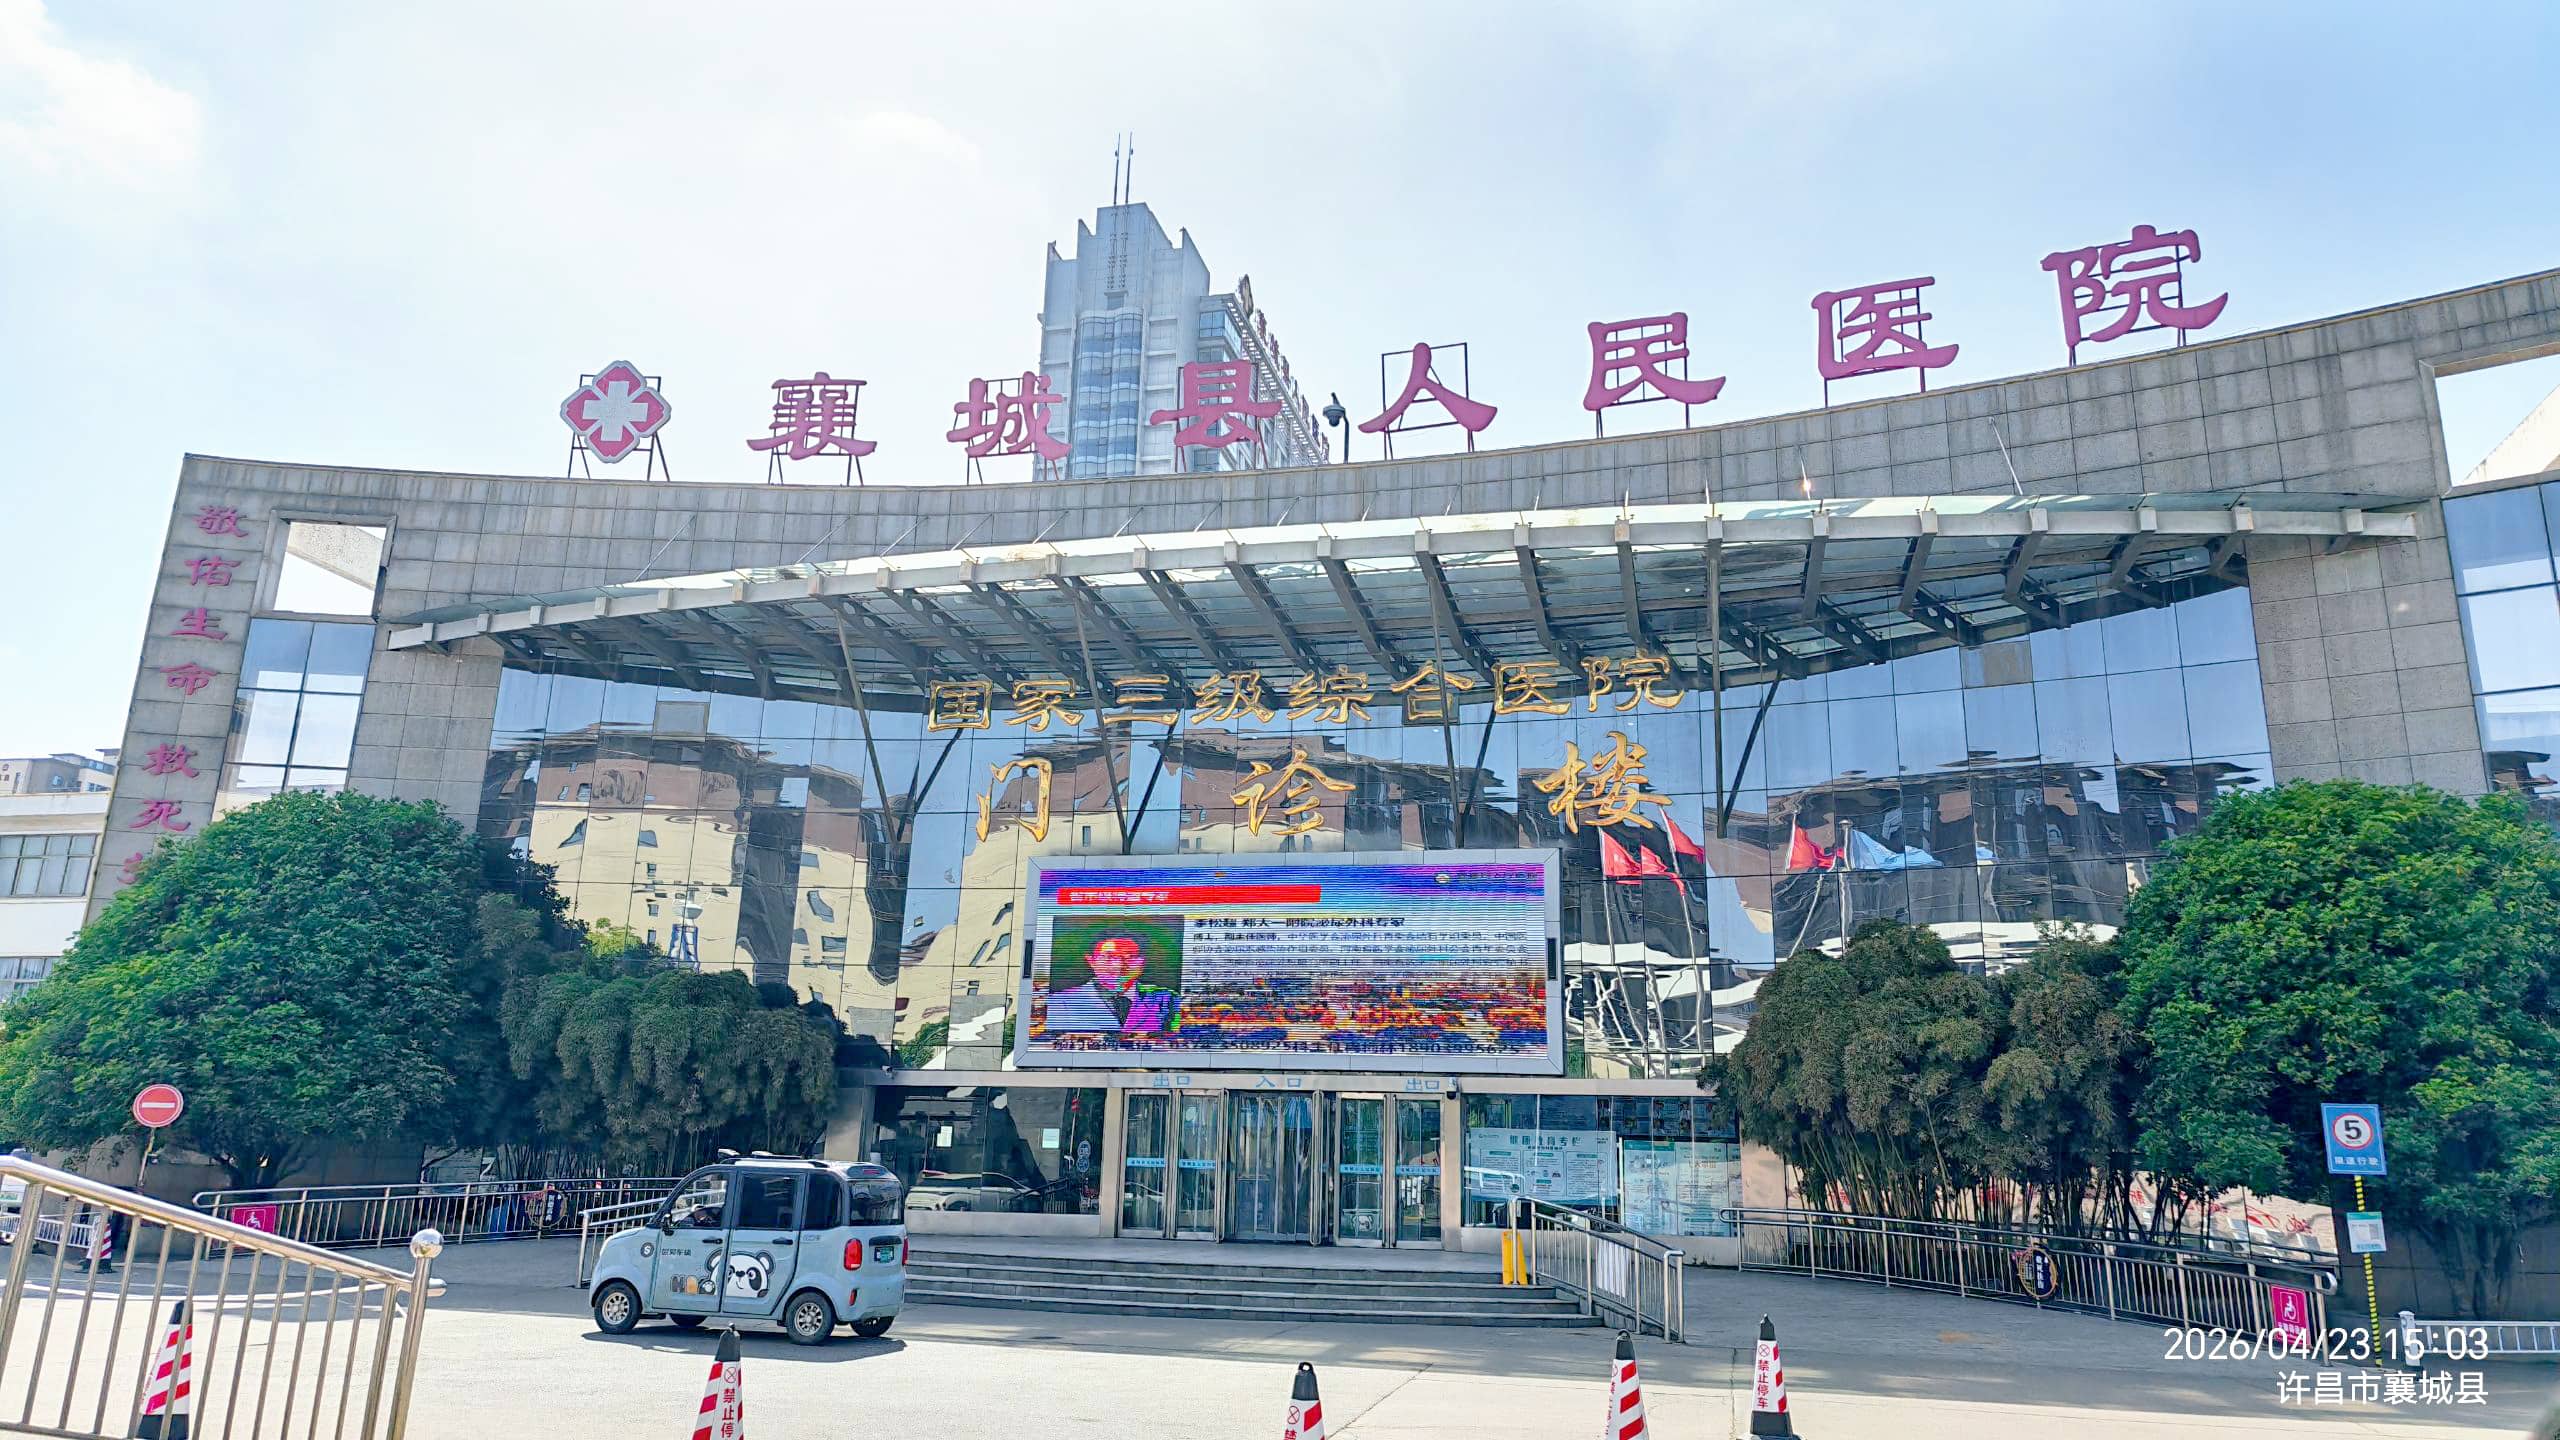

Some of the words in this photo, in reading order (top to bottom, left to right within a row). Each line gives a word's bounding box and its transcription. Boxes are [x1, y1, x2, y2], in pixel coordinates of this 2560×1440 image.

[746, 223, 2229, 463] 襄城县人民医院
[160, 504, 249, 697] 敬佑生命
[927, 648, 1686, 733] 国家三级综合医院
[976, 730, 1674, 843] 门诊楼
[1152, 1074, 1191, 1088] 出口
[1255, 1075, 1301, 1089] 入口
[1405, 1078, 1440, 1091] 出口
[2343, 1119, 2363, 1140] 5
[1756, 1359, 1770, 1409] 禁止停车
